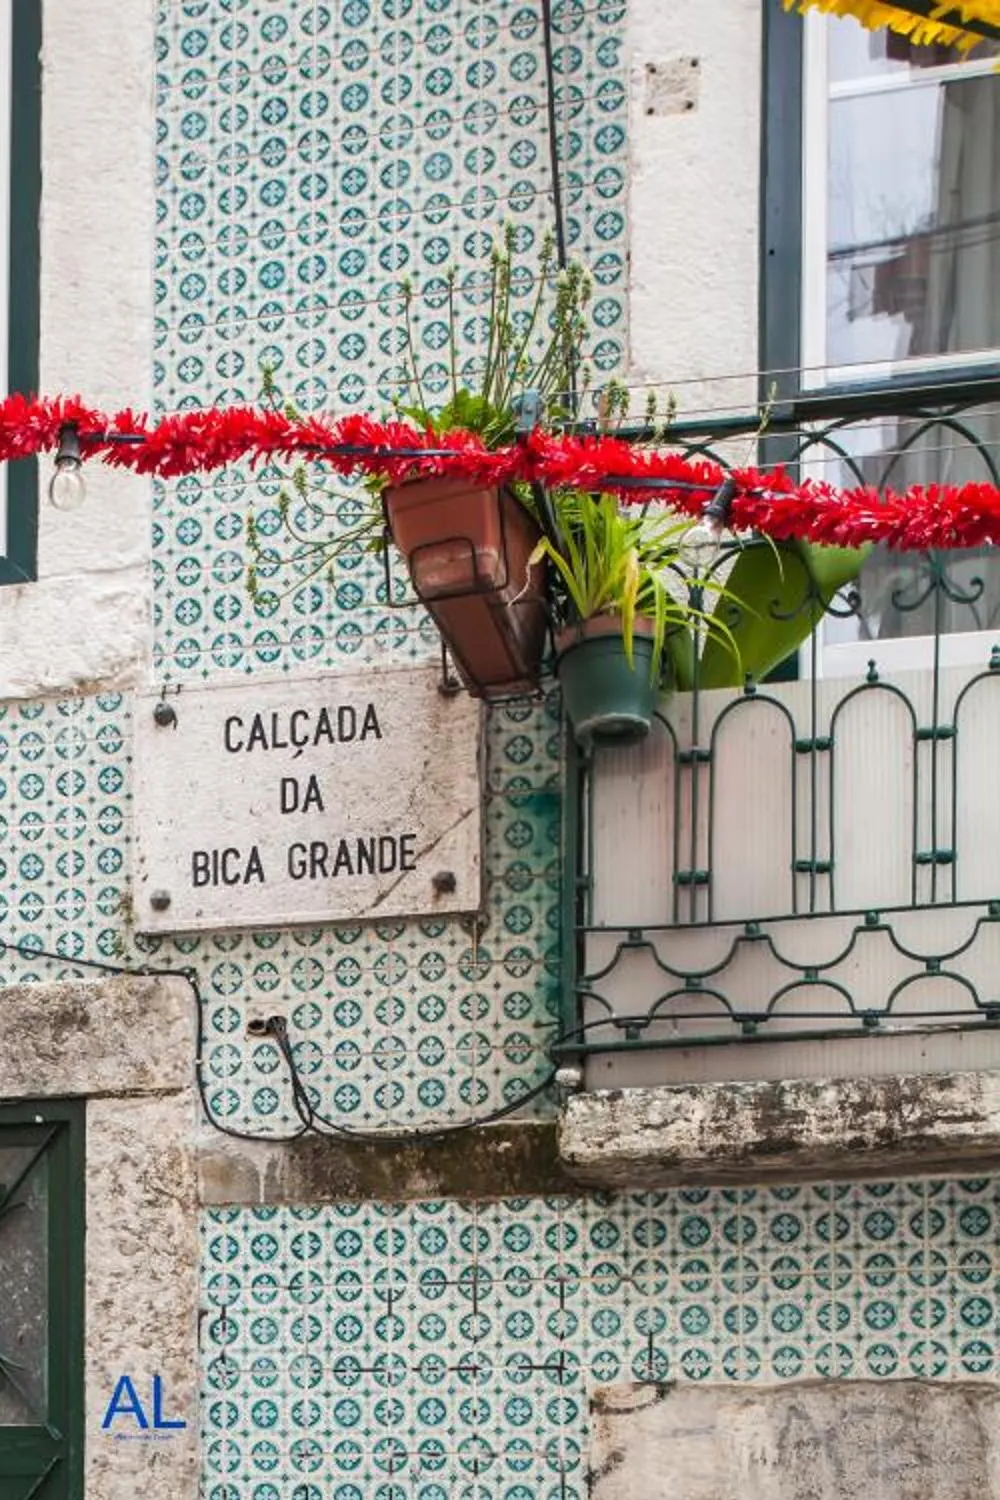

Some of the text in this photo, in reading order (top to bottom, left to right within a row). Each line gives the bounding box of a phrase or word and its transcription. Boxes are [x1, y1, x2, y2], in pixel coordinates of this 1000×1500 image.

[223, 703, 383, 759] CALÇADA
[280, 774, 325, 814] DA
[191, 833, 418, 888] BICA GRANDE
[101, 1374, 187, 1430] AL
